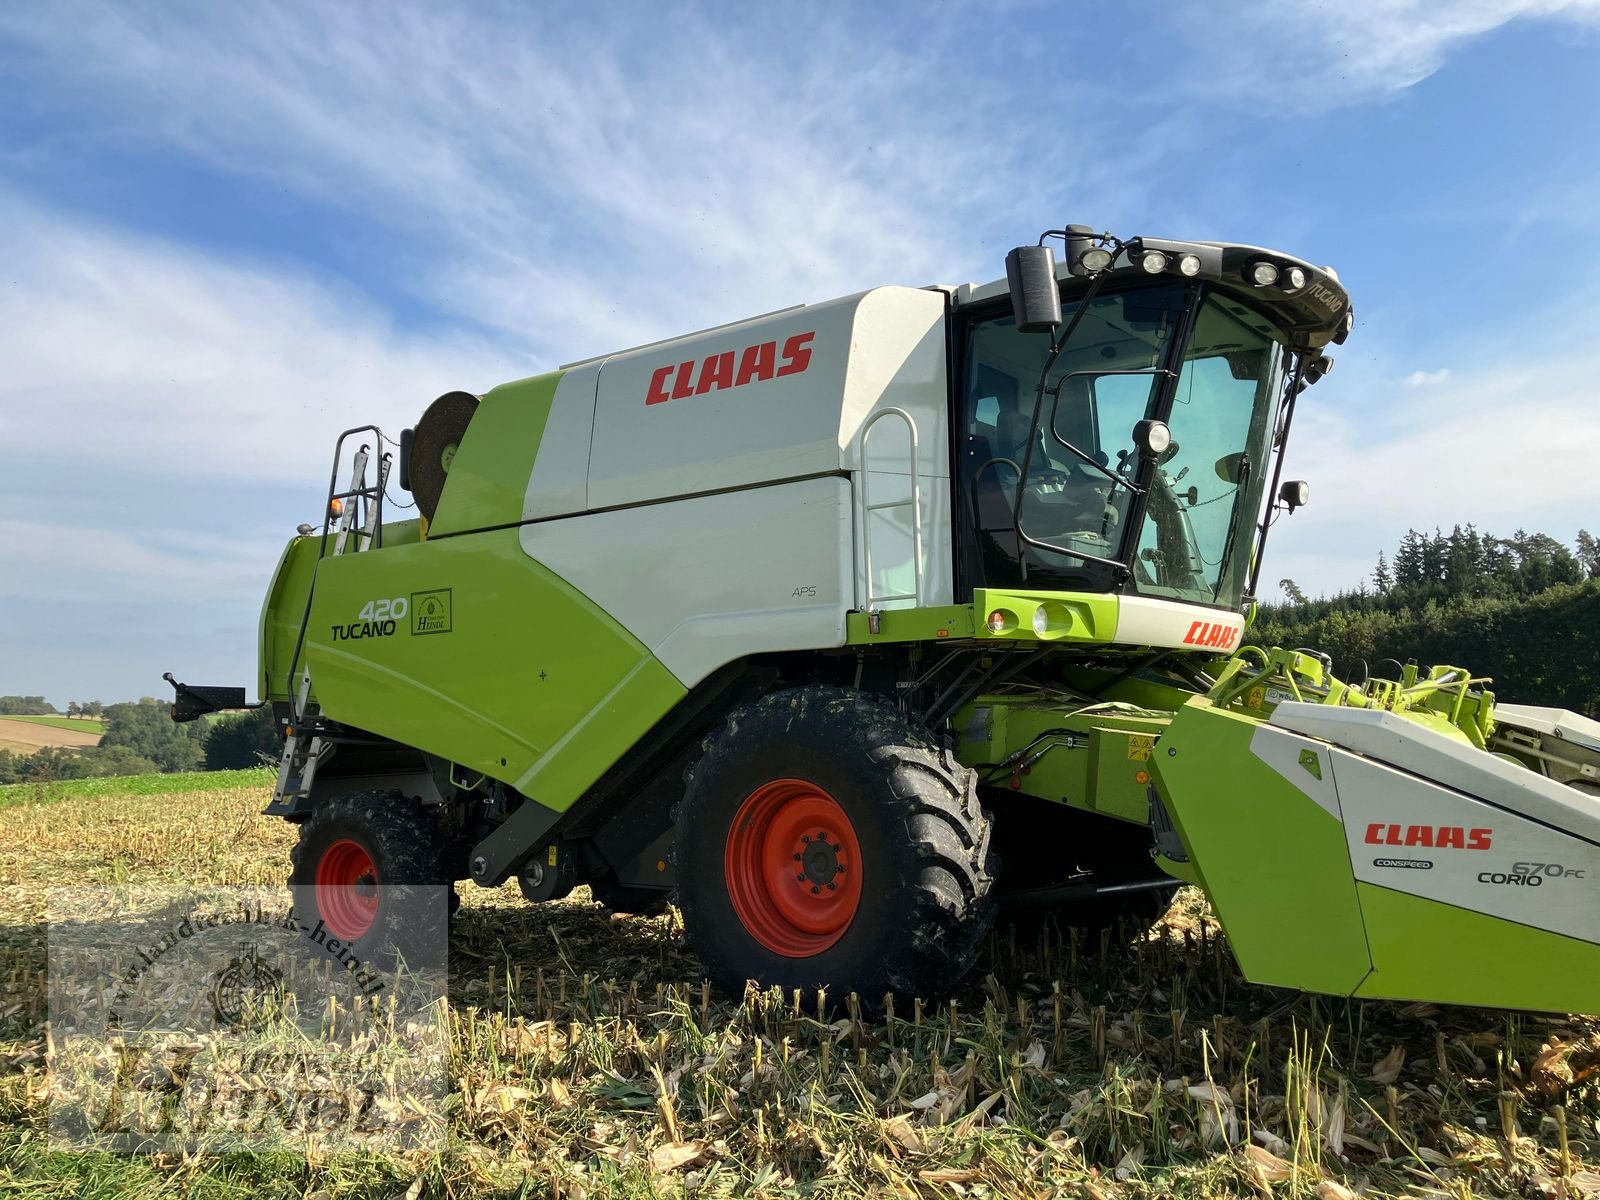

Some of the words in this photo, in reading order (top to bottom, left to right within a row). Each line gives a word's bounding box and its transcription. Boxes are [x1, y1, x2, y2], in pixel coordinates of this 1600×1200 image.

[1308, 282, 1343, 313] TUCANO
[645, 331, 816, 406] CLAAS
[791, 585, 817, 597] APS
[358, 597, 409, 623] 420
[331, 619, 396, 641] TUCANO
[1183, 620, 1239, 649] CLAAS
[1364, 823, 1493, 851] CLAAS
[1376, 859, 1431, 869] CONSPEED
[1477, 872, 1543, 887] CORIO
